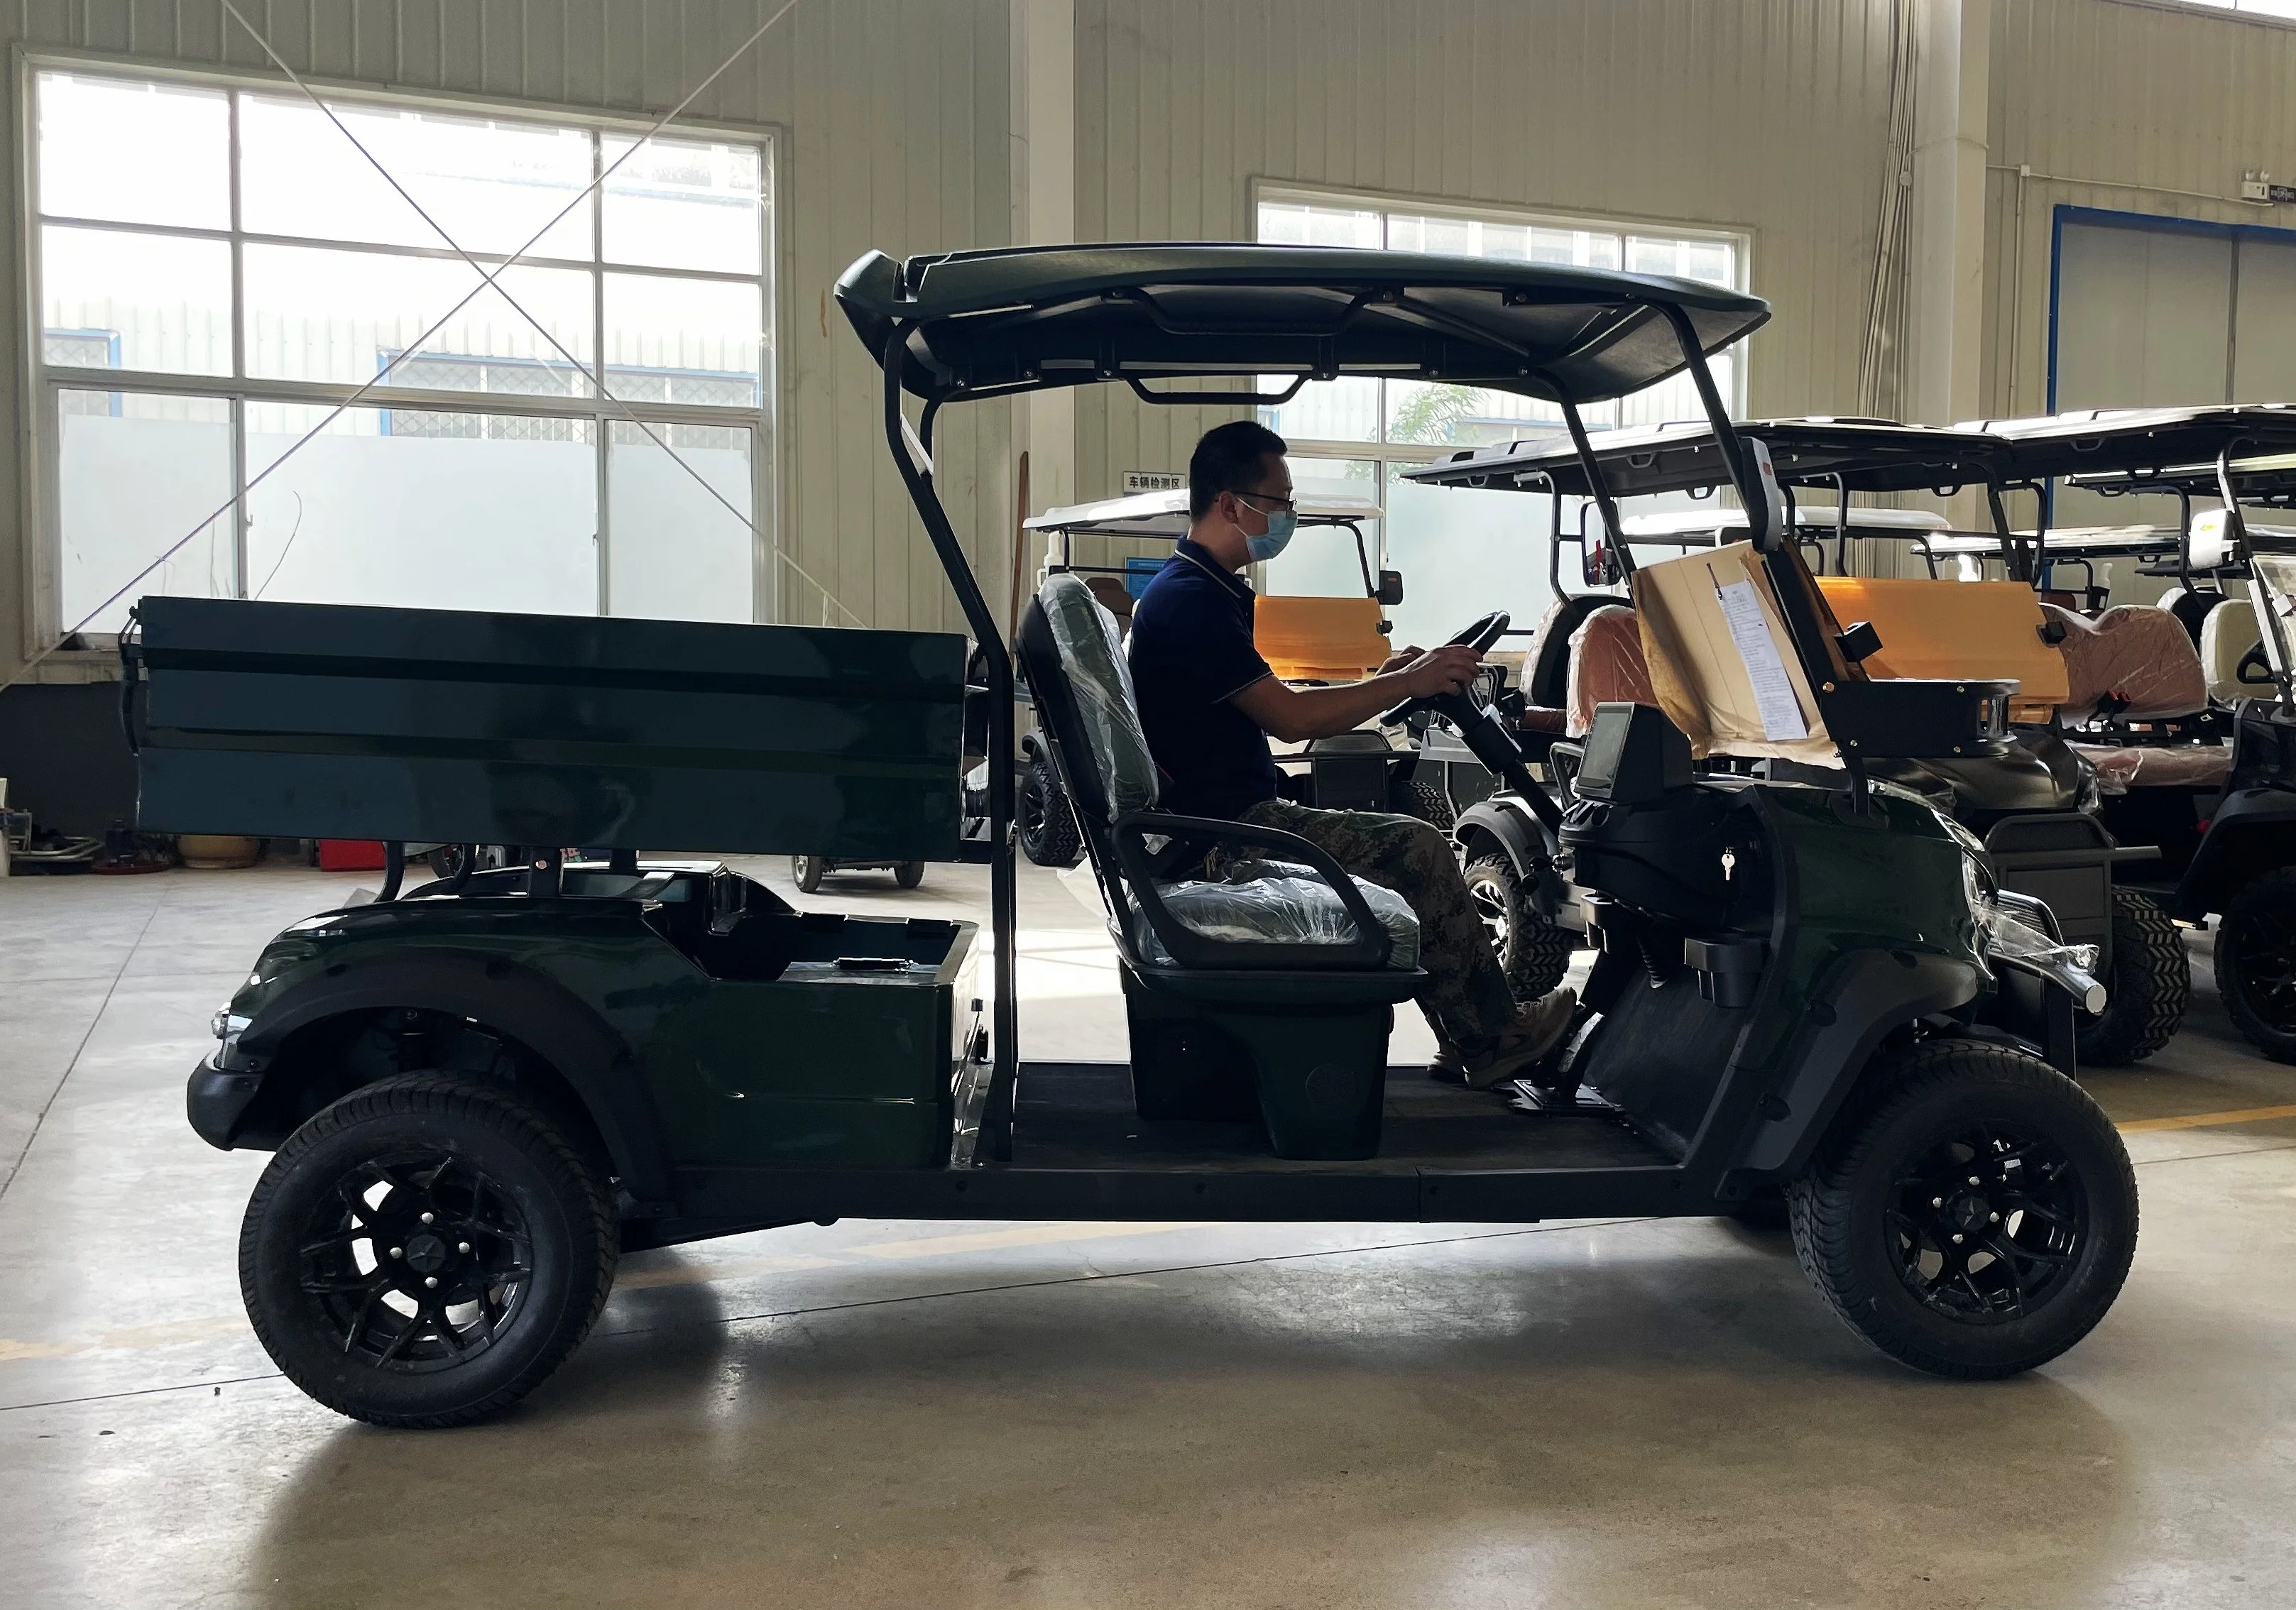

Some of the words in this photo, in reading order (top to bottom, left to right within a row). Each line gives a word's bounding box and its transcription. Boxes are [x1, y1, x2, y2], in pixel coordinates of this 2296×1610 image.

[1129, 476, 1180, 489] 车辆检测区
